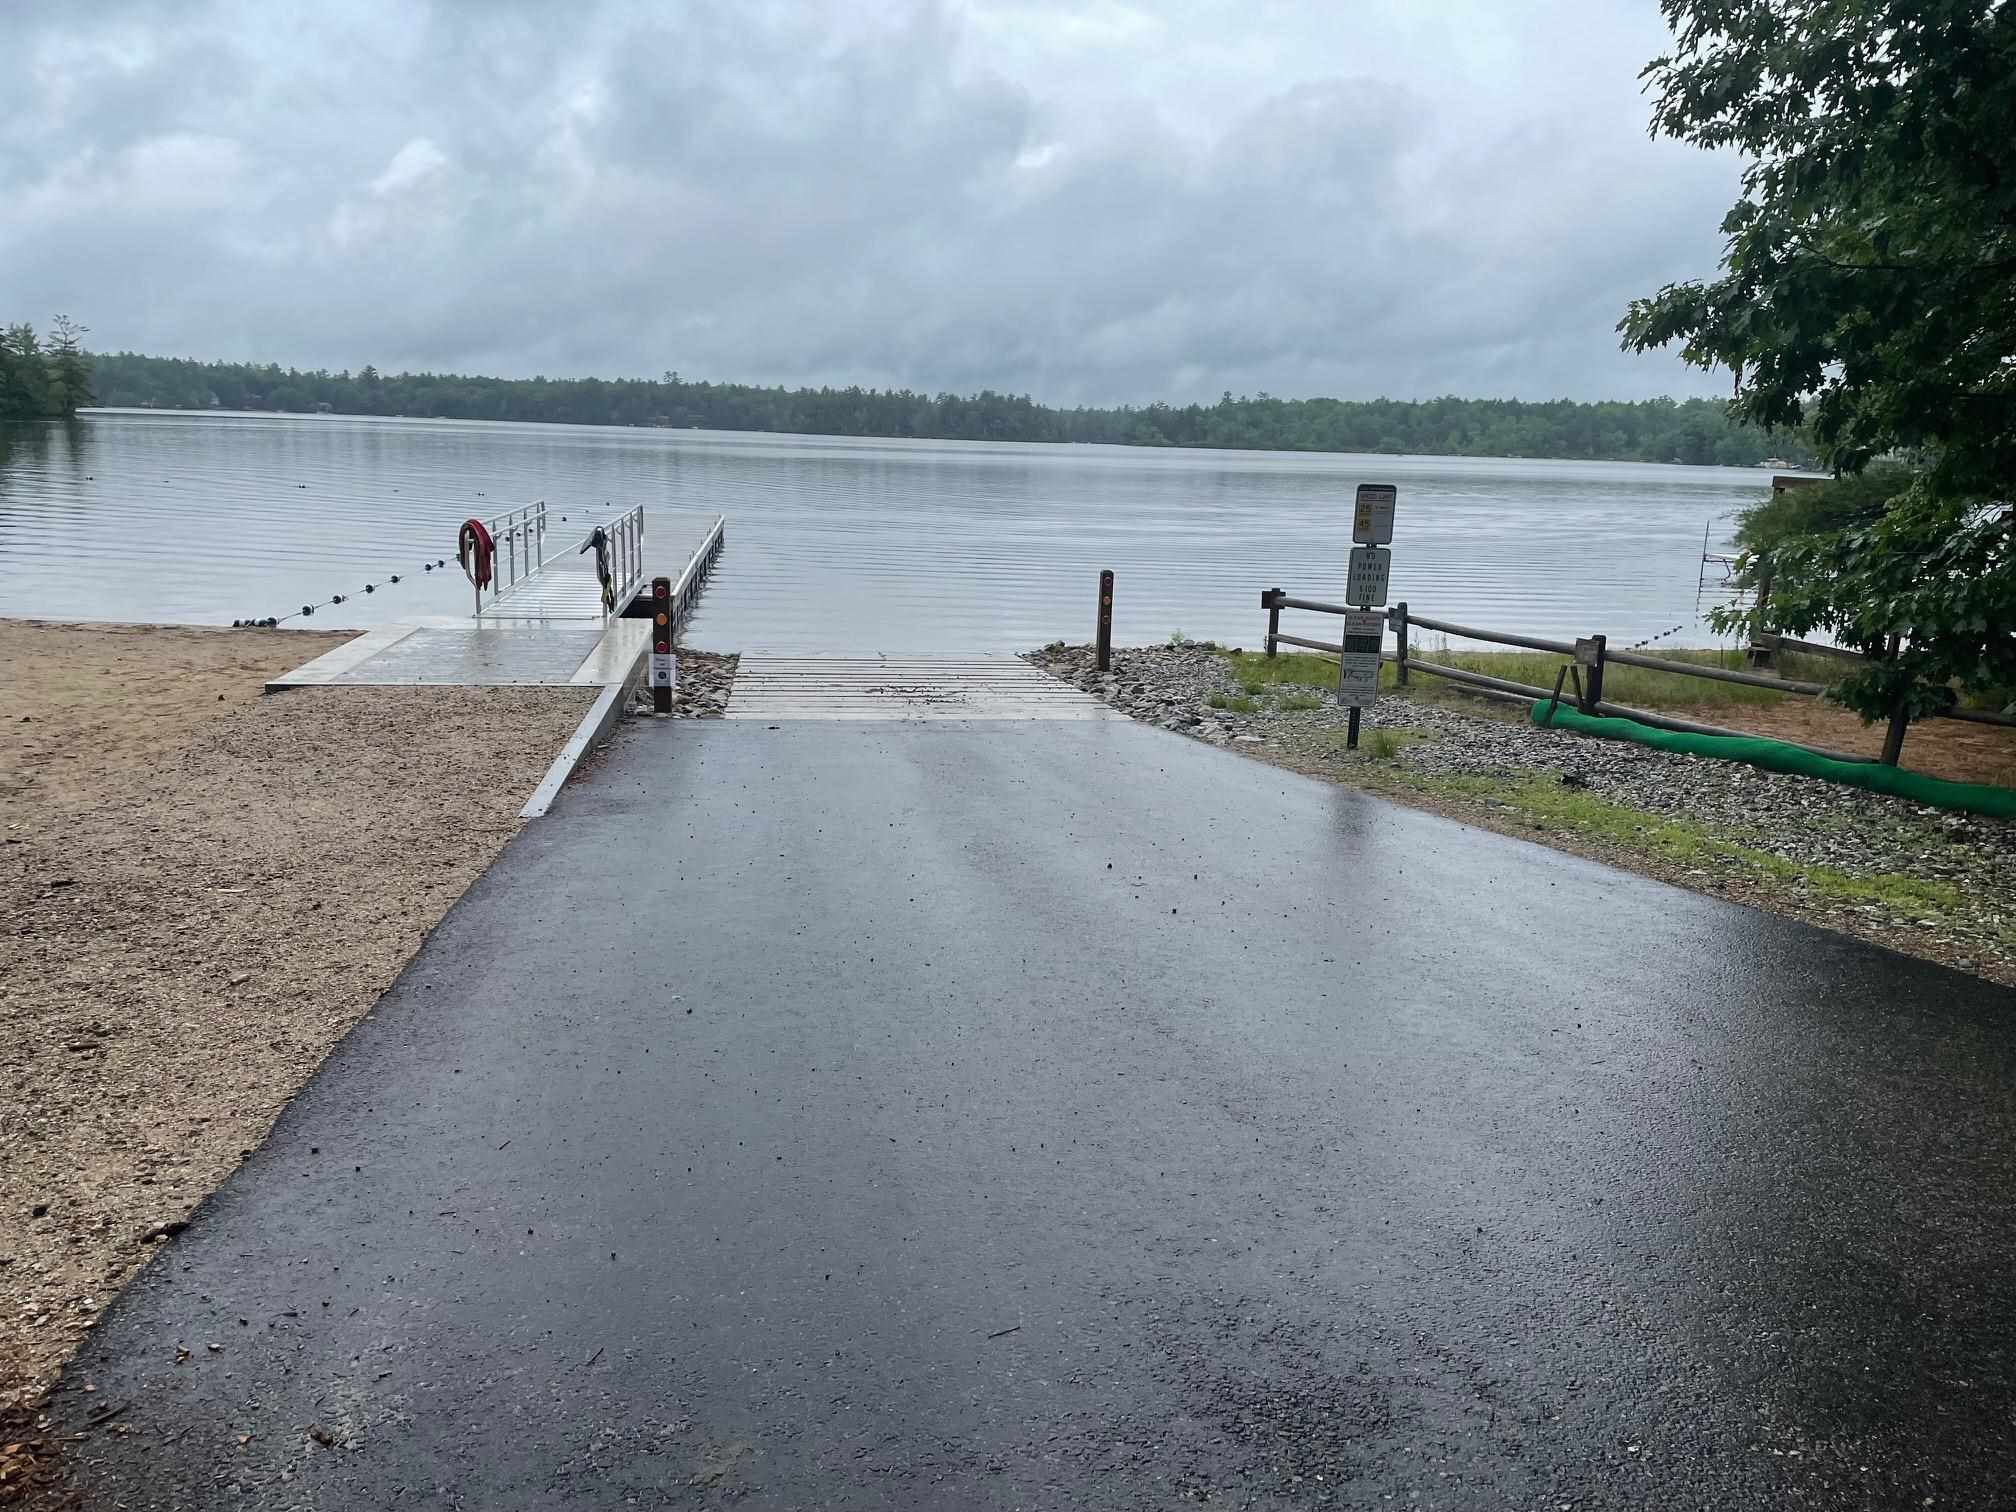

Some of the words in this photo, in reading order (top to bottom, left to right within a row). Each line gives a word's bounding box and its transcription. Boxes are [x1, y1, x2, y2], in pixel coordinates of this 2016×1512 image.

[1358, 561, 1383, 572] POWER
[1352, 573, 1386, 582] LOADING
[1358, 592, 1376, 602] FINE
